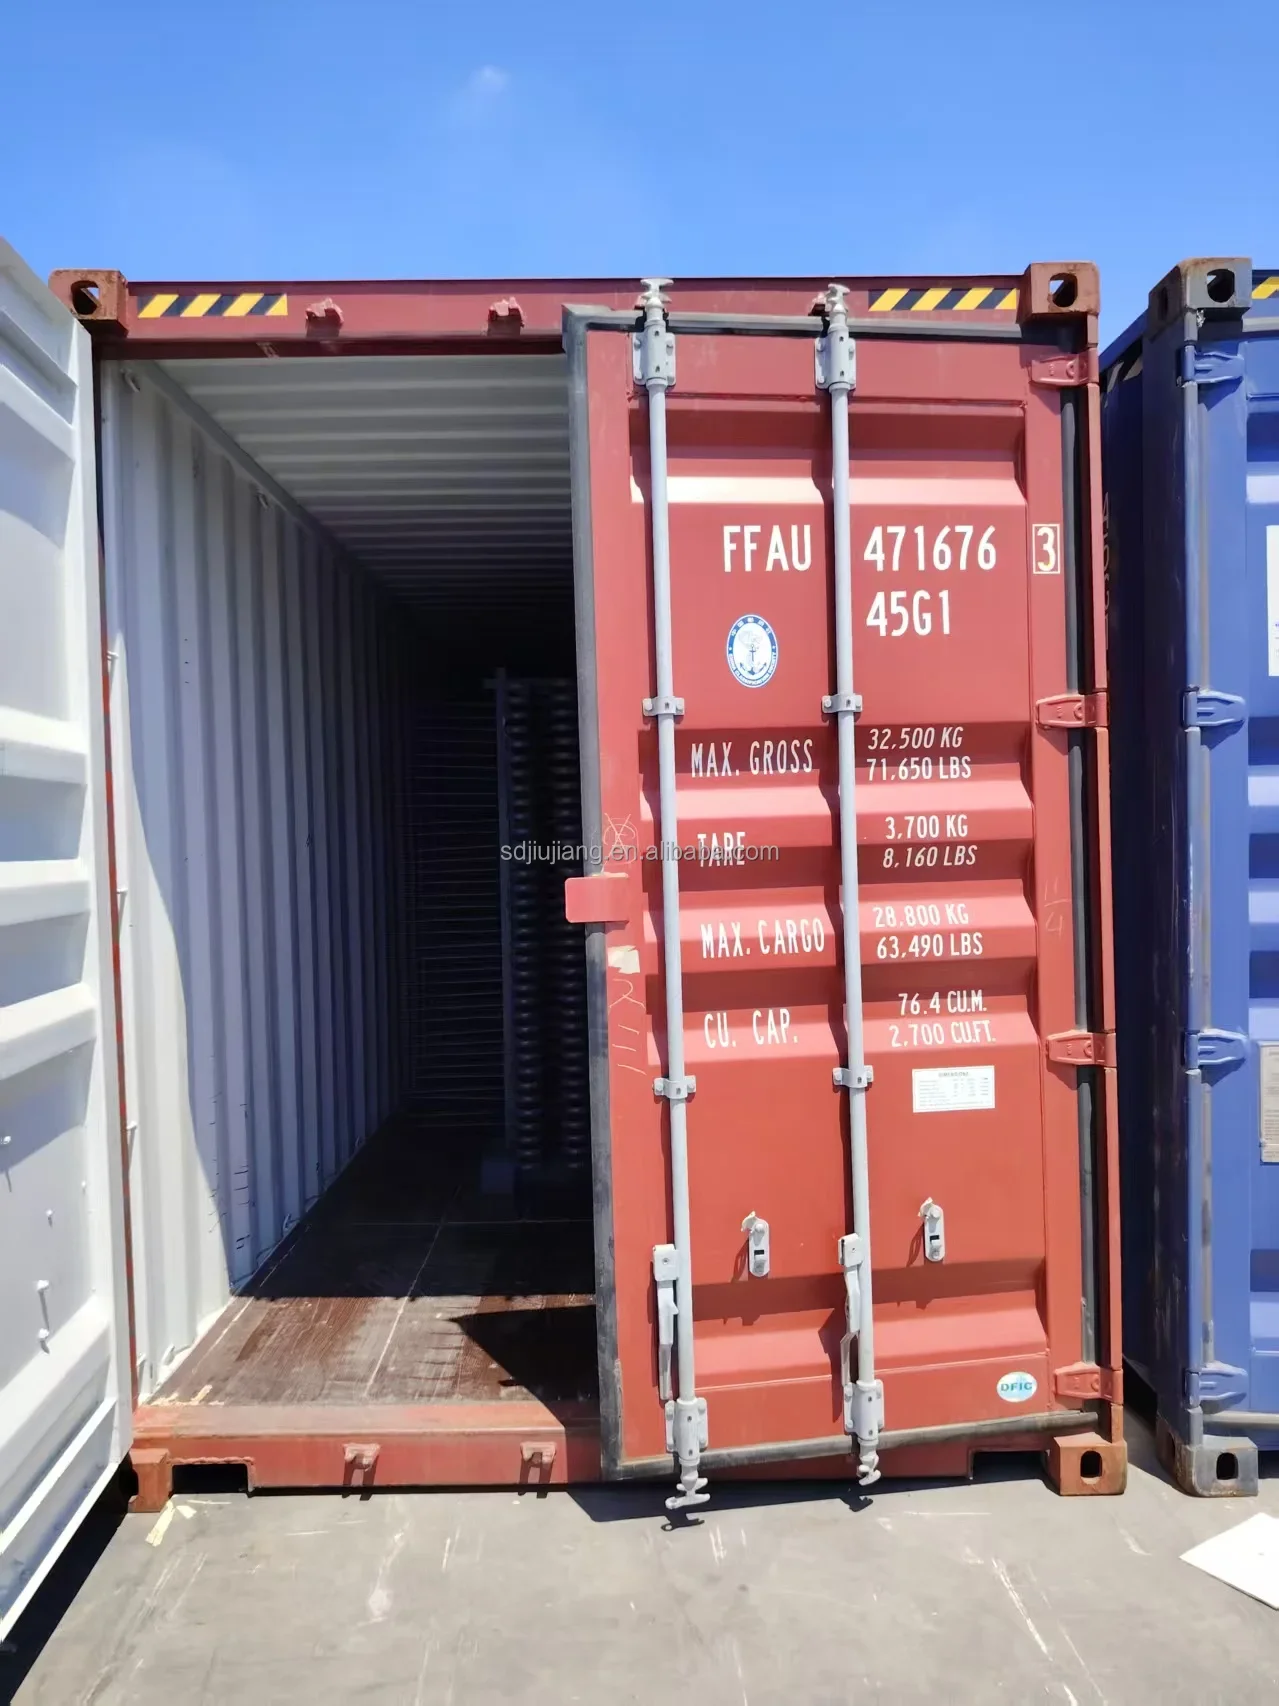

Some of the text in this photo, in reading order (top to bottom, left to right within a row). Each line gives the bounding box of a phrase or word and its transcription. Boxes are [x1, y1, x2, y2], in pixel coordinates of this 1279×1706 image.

[723, 524, 1057, 573] FFAU 471676 3
[866, 590, 951, 637] 45G1
[868, 726, 964, 750] 32,500 KG
[691, 739, 813, 778] MAX. GROSS
[866, 756, 972, 782] 71,650 LBS
[885, 814, 969, 840] 3,700 KG
[697, 831, 746, 868] TARE
[882, 845, 978, 869] 8,160 LBS
[945, 903, 969, 926] KG
[700, 918, 825, 959] MAX. CARGO
[877, 932, 983, 960] 63,490 LBS
[898, 989, 988, 1016] 76.4 CU.M.
[704, 1008, 798, 1049] CU. CAP.
[1000, 1382, 1033, 1392] DFIC
